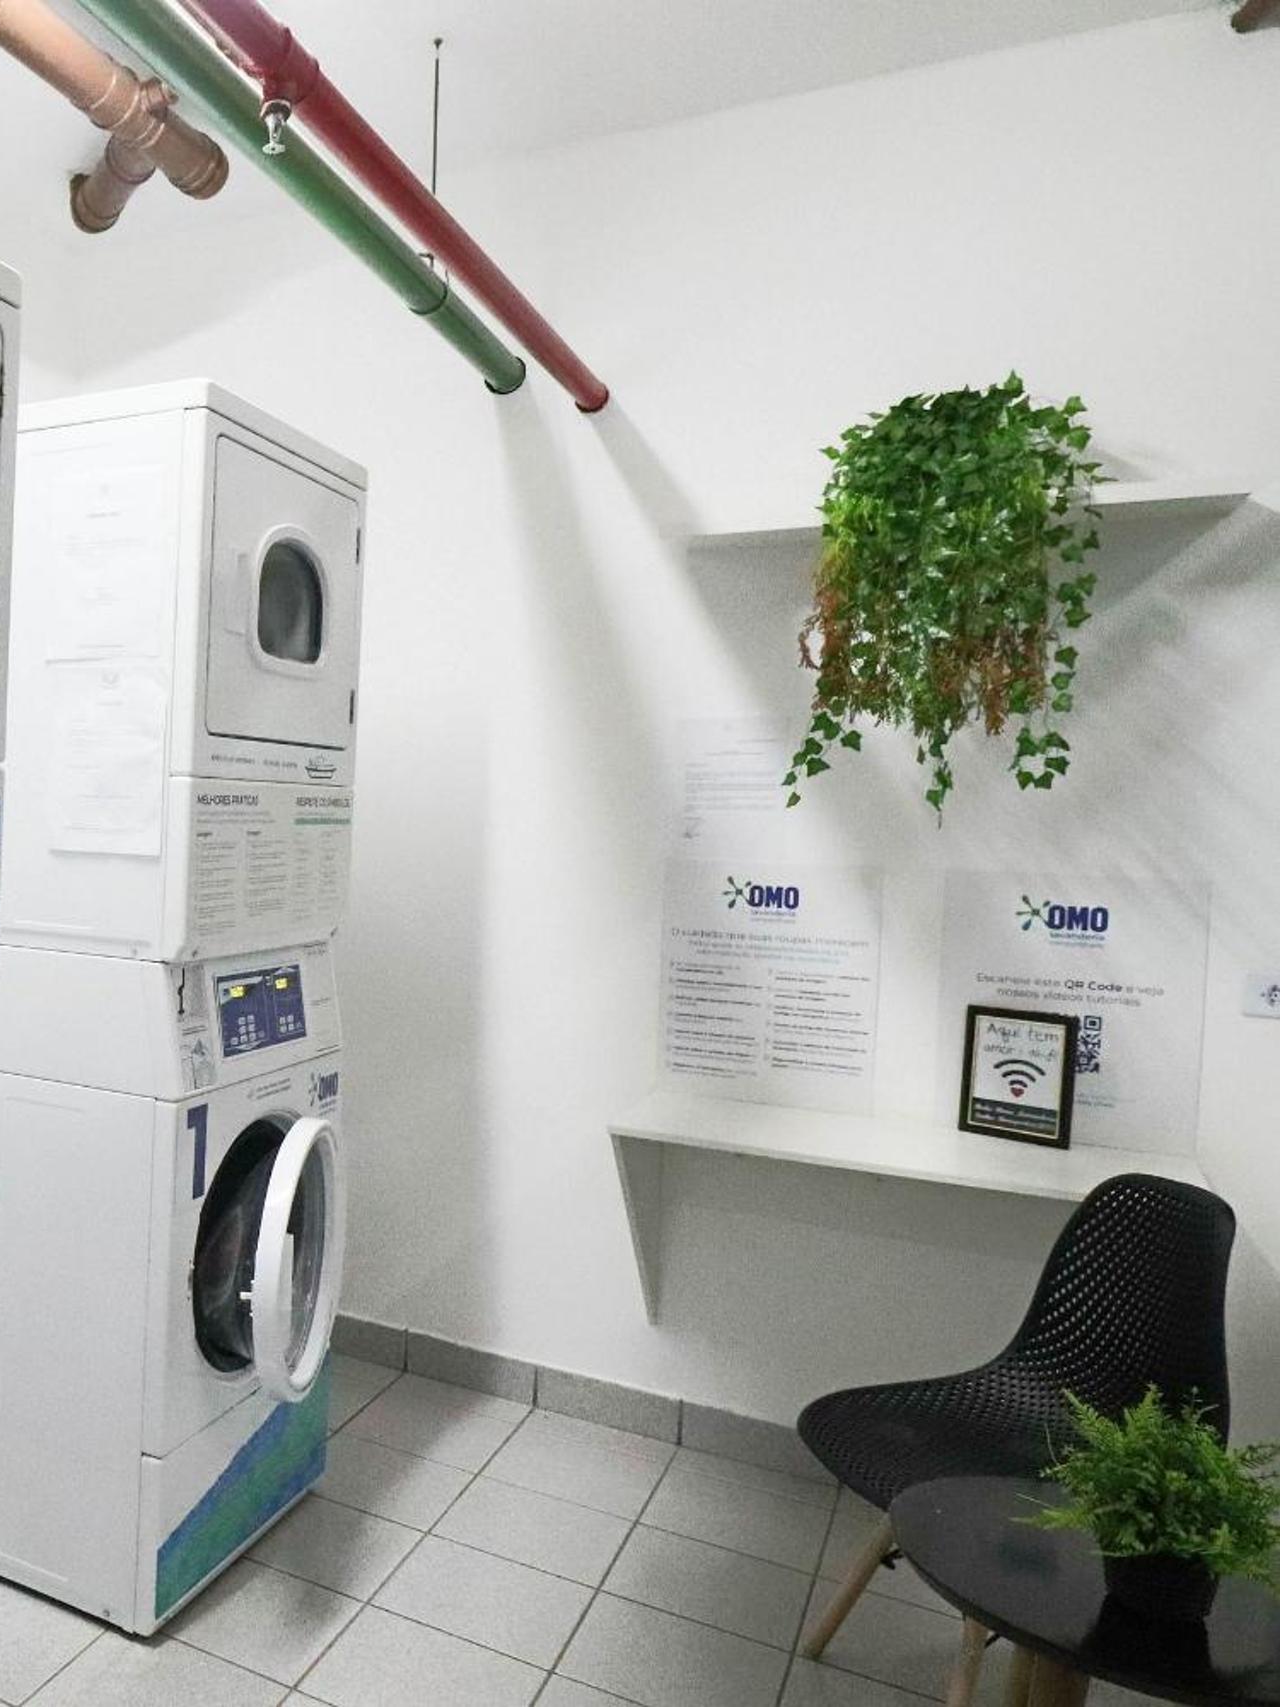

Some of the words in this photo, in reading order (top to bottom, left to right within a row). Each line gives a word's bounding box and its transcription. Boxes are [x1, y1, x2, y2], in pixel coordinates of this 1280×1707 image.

[748, 884, 801, 911] OMO
[1047, 904, 1110, 933] OMO
[1088, 980, 1123, 993] Code
[187, 1103, 209, 1201] 1
